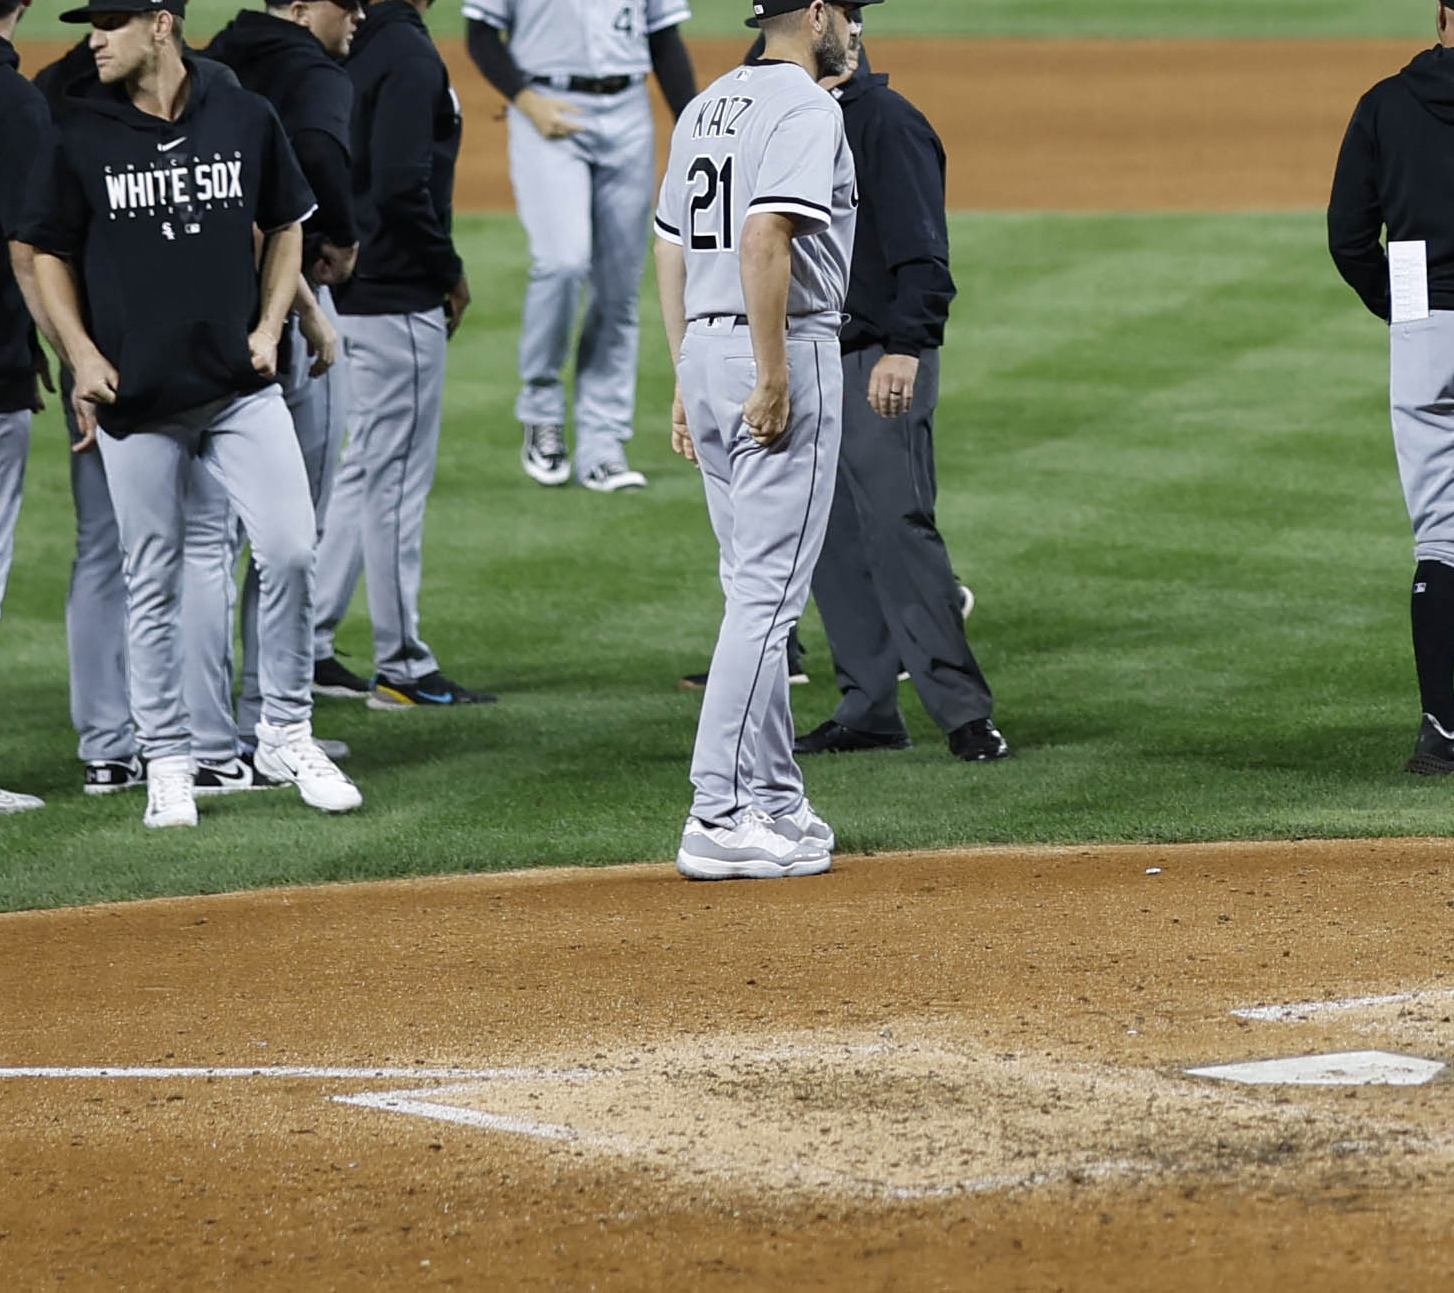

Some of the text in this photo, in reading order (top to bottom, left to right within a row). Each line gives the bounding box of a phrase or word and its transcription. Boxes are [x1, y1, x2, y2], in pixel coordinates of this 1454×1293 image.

[691, 95, 754, 141] KATZ
[104, 150, 242, 174] CHICAGO
[105, 160, 244, 211] WHITE SOX
[686, 153, 735, 253] 21
